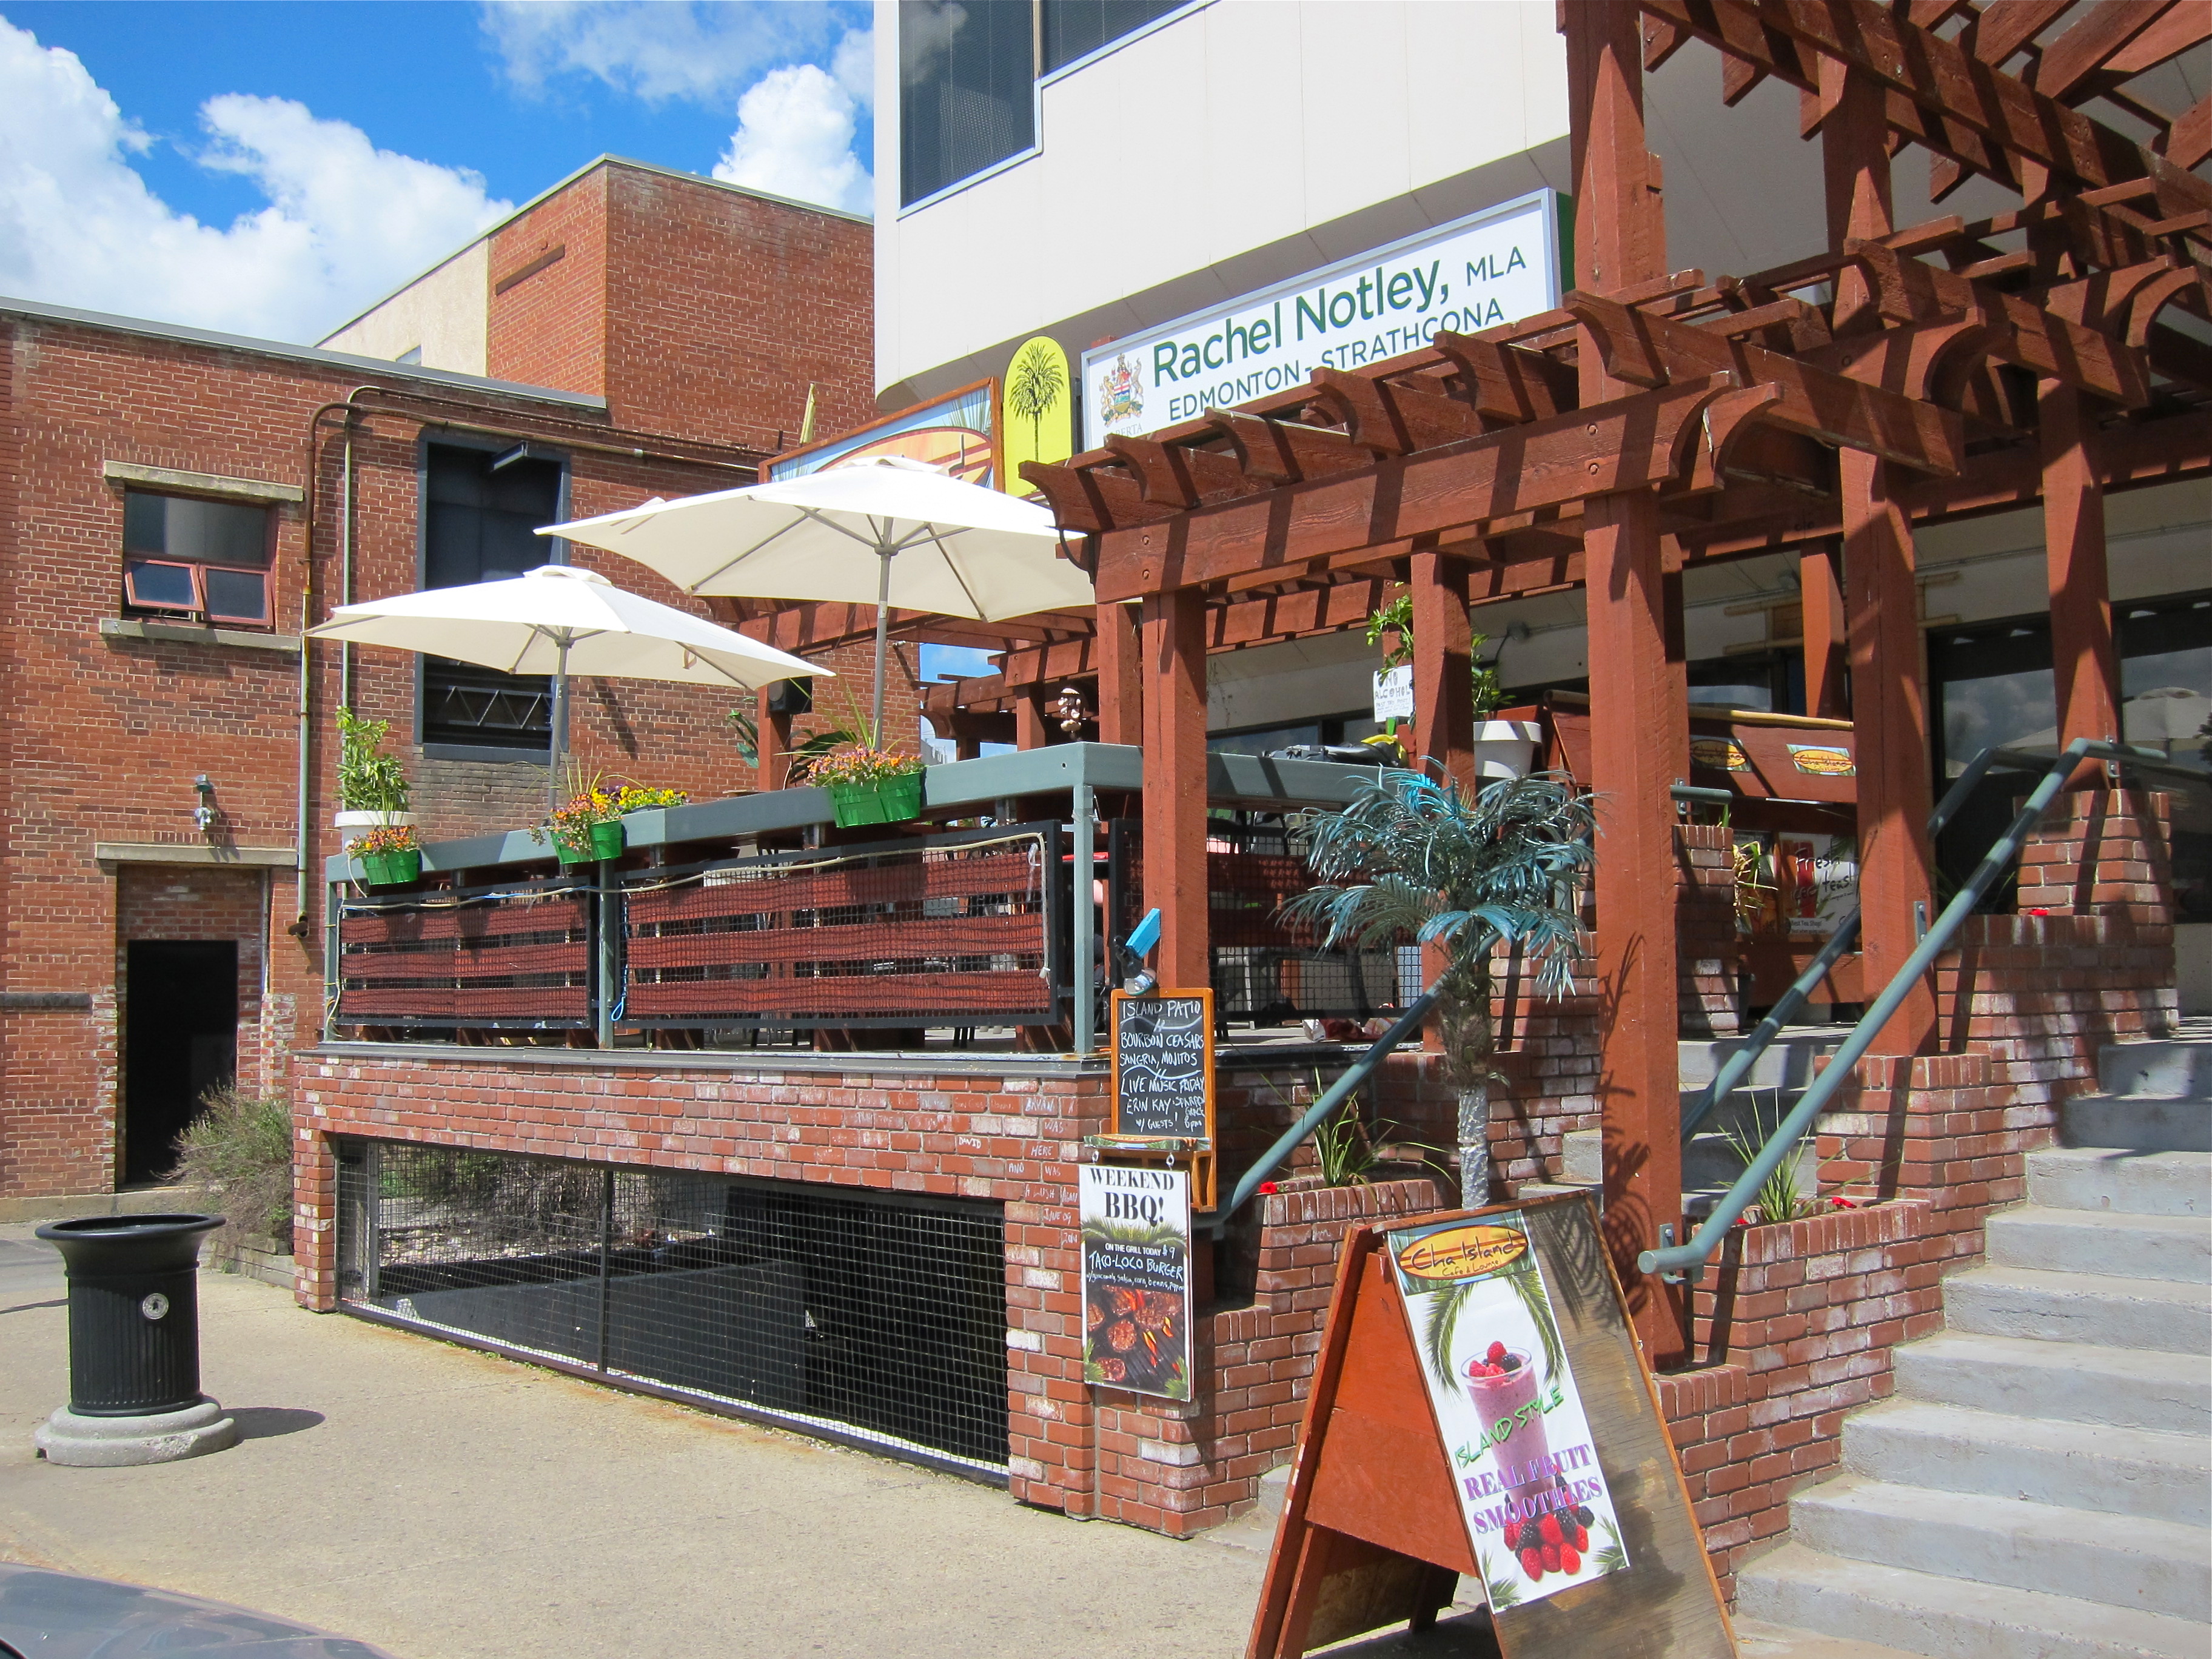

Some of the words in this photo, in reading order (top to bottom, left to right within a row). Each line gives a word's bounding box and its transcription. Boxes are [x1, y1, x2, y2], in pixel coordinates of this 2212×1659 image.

[1153, 301, 1283, 388] Rachel
[1296, 259, 1449, 341] Notley,
[1466, 246, 1527, 287] MLA
[1375, 685, 1410, 700] ALCOHOL
[1123, 1001, 1162, 1019] ISLAND
[1167, 1000, 1201, 1018] PATIO
[1121, 1032, 1163, 1048] BOURBON
[1119, 1053, 1159, 1069] SANGRIA,
[1161, 1050, 1198, 1066] MOJITOS
[1121, 1076, 1147, 1096] LIVE
[1149, 1079, 1177, 1092] MUSIC
[1179, 1076, 1205, 1094] FRIDAY
[1025, 1097, 1054, 1111] BRYAN
[1127, 1097, 1148, 1114] ERIN
[1152, 1098, 1171, 1114] KAY
[1045, 1122, 1064, 1133] WAS
[959, 1136, 982, 1149] DAVID
[1031, 1145, 1053, 1156] HERE
[1045, 1165, 1061, 1176] WAS
[1090, 1168, 1174, 1190] WEEKEND
[1104, 1191, 1164, 1227] BBQ!
[1105, 1242, 1114, 1251] ON
[1114, 1244, 1125, 1253] THE
[1126, 1245, 1141, 1255] GRILL
[1142, 1247, 1161, 1256] TODAY
[1410, 1243, 1455, 1270] Cha
[1461, 1230, 1514, 1261] Island
[1147, 1258, 1183, 1282] BURGER
[1442, 1267, 1463, 1277] Cafe
[1472, 1259, 1499, 1272] Lounge
[1455, 1417, 1513, 1470] ISLAND
[1514, 1385, 1564, 1429] STYLE
[1463, 1465, 1526, 1501] REAL
[1526, 1443, 1592, 1483] FRUIT
[1473, 1476, 1603, 1535] SMOOTHIES
